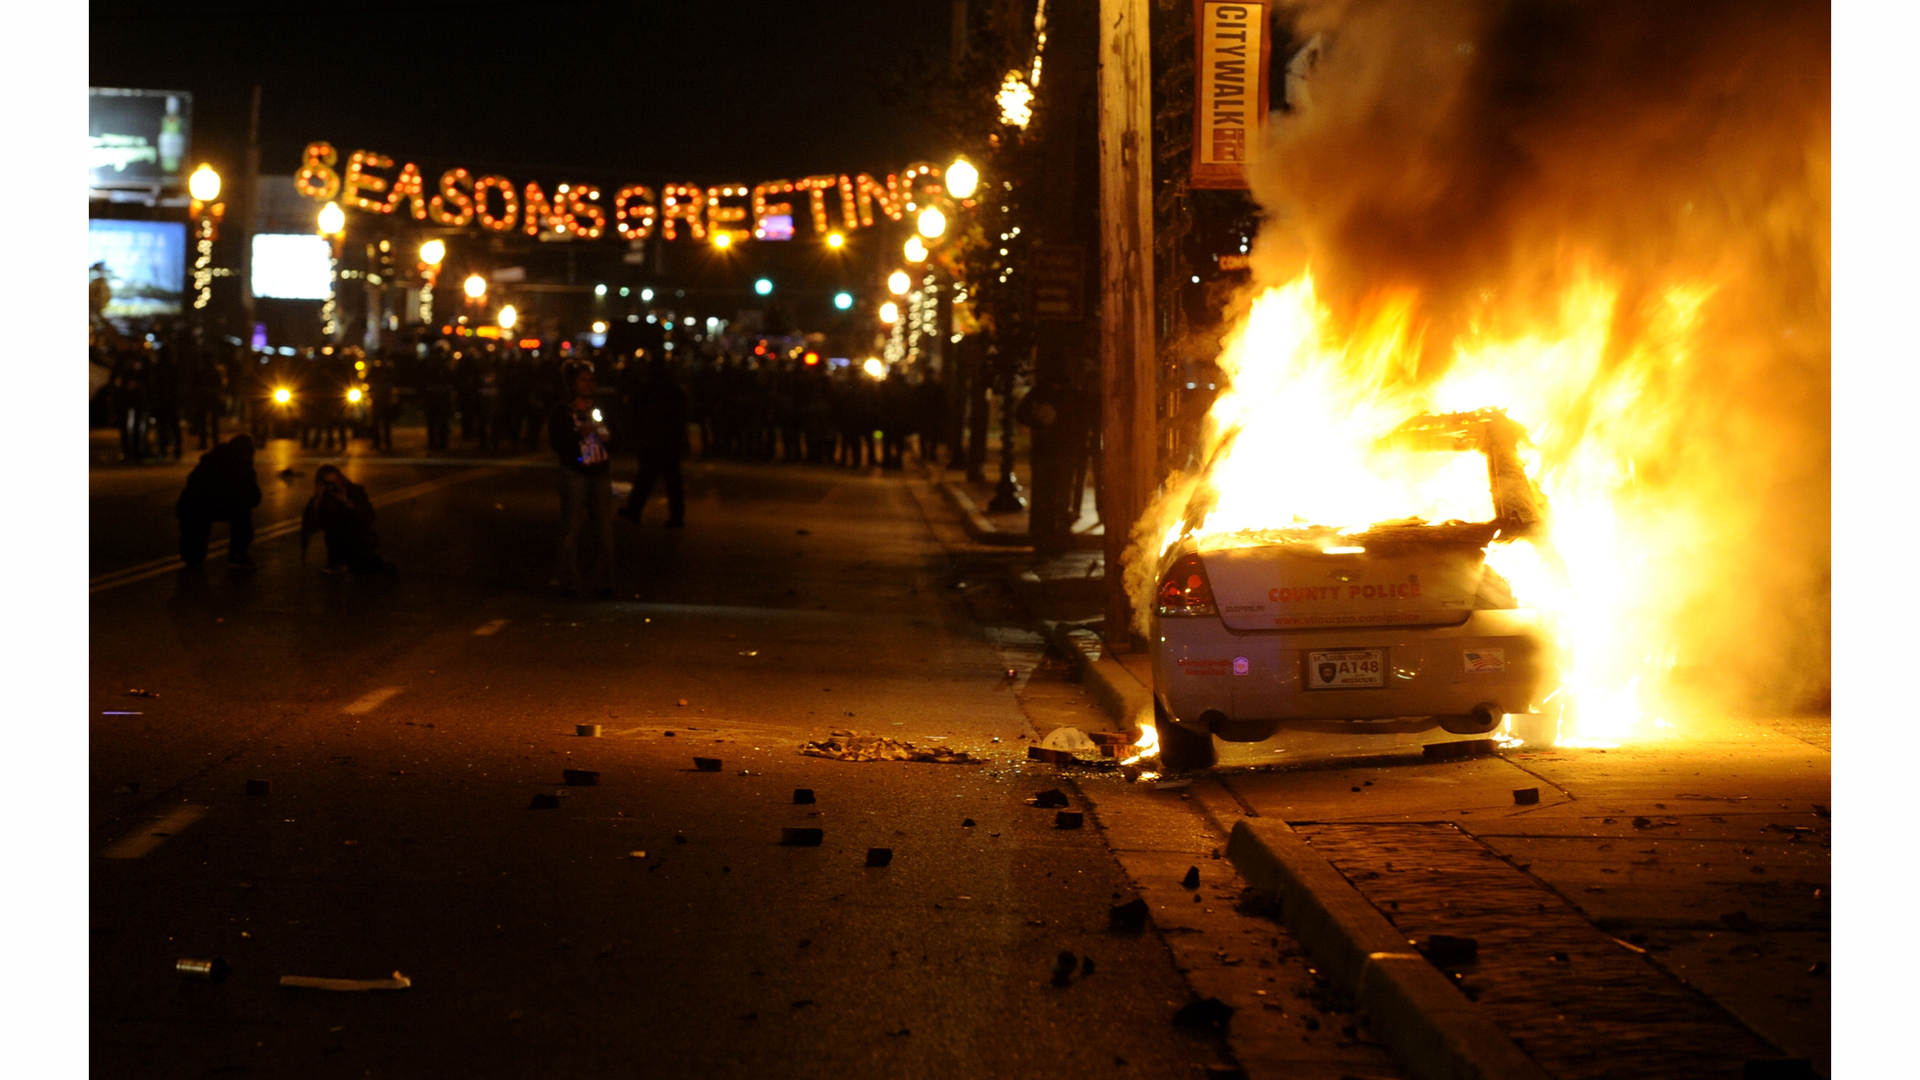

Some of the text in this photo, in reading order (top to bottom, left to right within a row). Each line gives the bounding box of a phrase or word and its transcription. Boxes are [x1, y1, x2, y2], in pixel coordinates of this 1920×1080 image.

[1213, 5, 1248, 126] CITYWALK
[294, 141, 606, 240] SEASONS
[1268, 583, 1421, 602] COUNTY POLICE
[1338, 660, 1379, 674] A148
